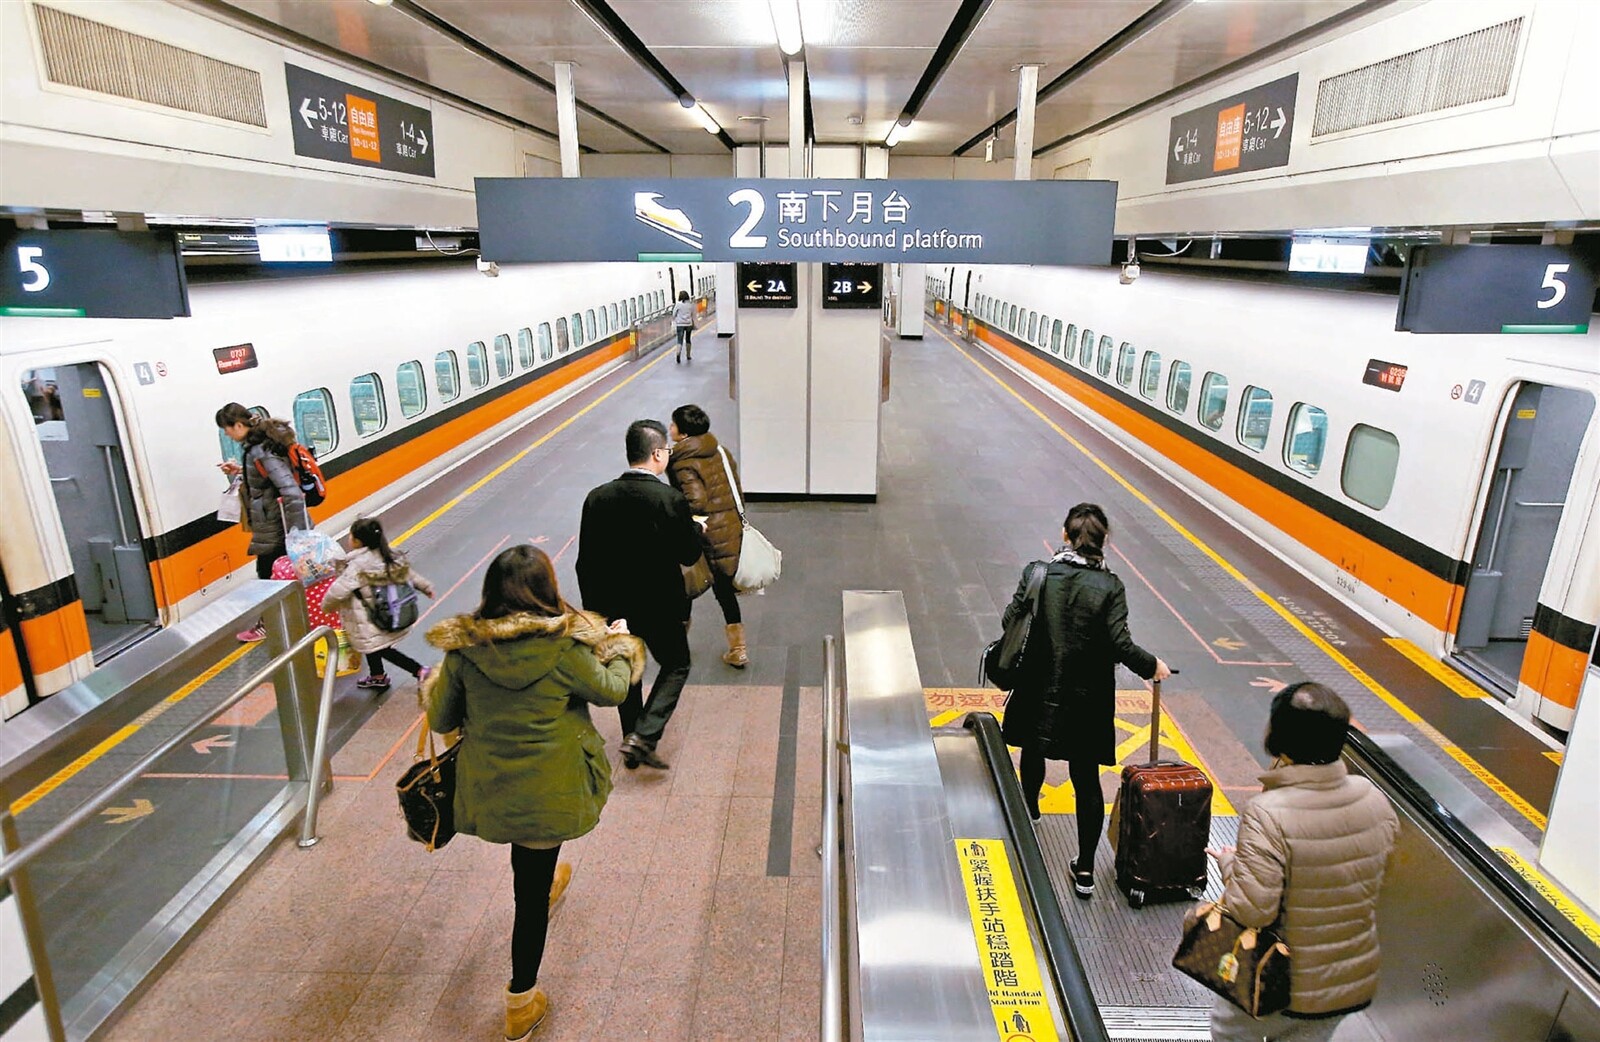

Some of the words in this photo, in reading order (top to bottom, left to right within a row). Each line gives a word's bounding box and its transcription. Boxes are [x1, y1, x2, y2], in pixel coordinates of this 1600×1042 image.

[318, 97, 347, 125] 5-12
[351, 106, 375, 128] 自由座
[1243, 106, 1270, 134] 5-12
[400, 120, 415, 142] 1-4
[1219, 116, 1241, 137] 自由座
[1186, 128, 1198, 148] 1-4
[727, 188, 769, 249] 2
[776, 190, 911, 225] 南下月台
[777, 228, 897, 250] Southbound
[902, 228, 984, 252] platform
[18, 246, 51, 292] 5
[767, 280, 786, 293] 2A
[832, 281, 852, 293] 2B
[1536, 263, 1570, 309] 5
[140, 365, 151, 381] 4
[1469, 383, 1481, 400] 4
